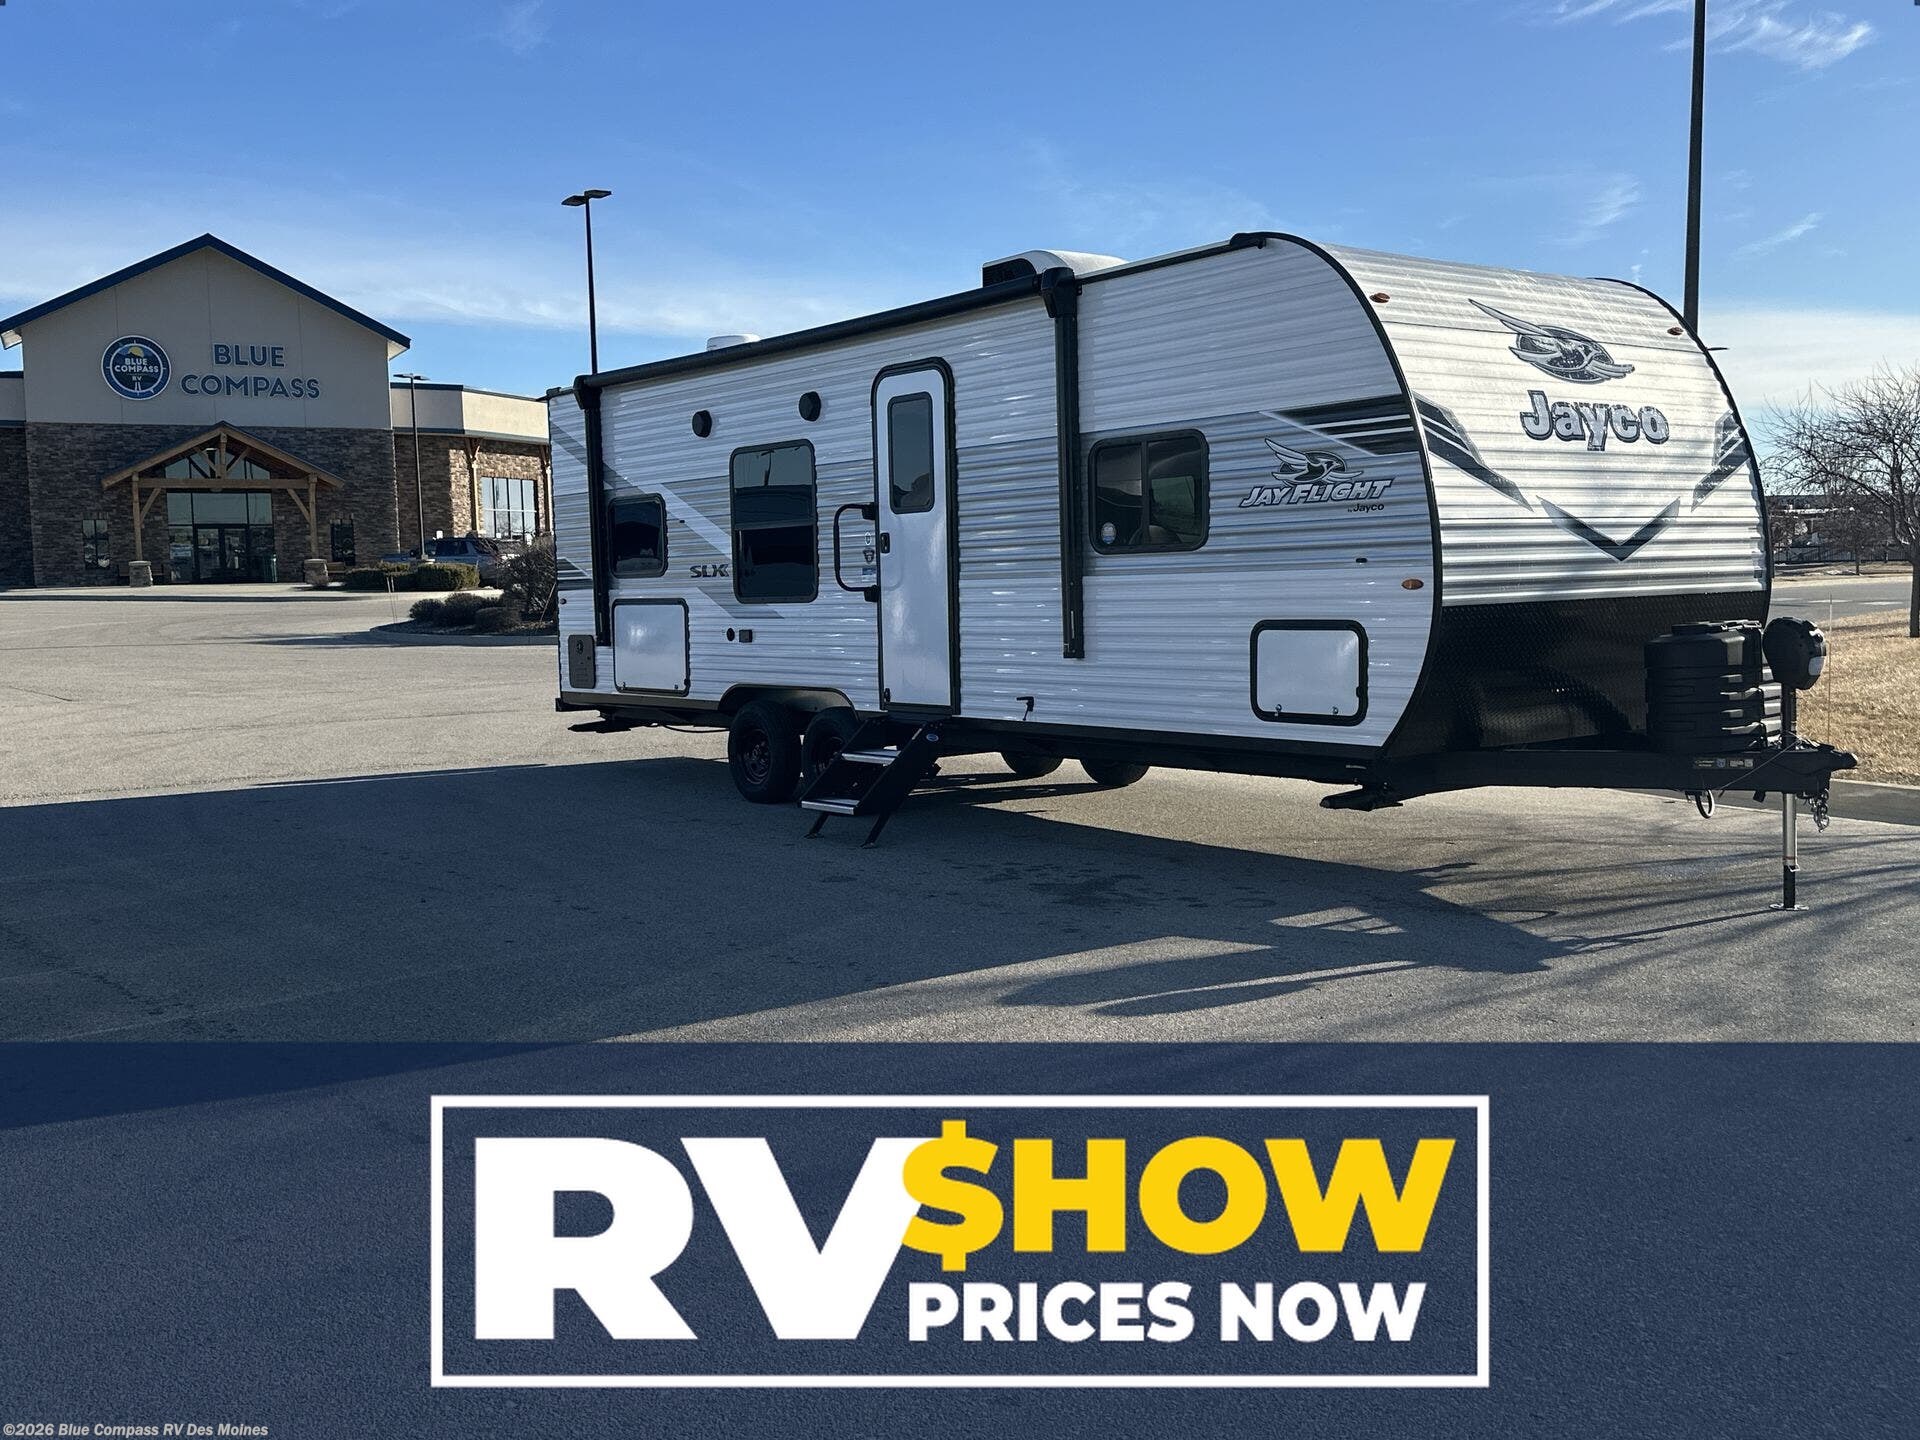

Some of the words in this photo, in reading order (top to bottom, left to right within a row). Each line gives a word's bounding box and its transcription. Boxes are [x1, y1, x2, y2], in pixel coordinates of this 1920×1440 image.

[124, 357, 148, 366] BLUE
[213, 343, 286, 368] BLUE
[114, 365, 159, 373] COMPASS
[180, 374, 321, 399] COMPASS
[1519, 389, 1670, 452] Jayco
[1353, 503, 1385, 513] Jayco
